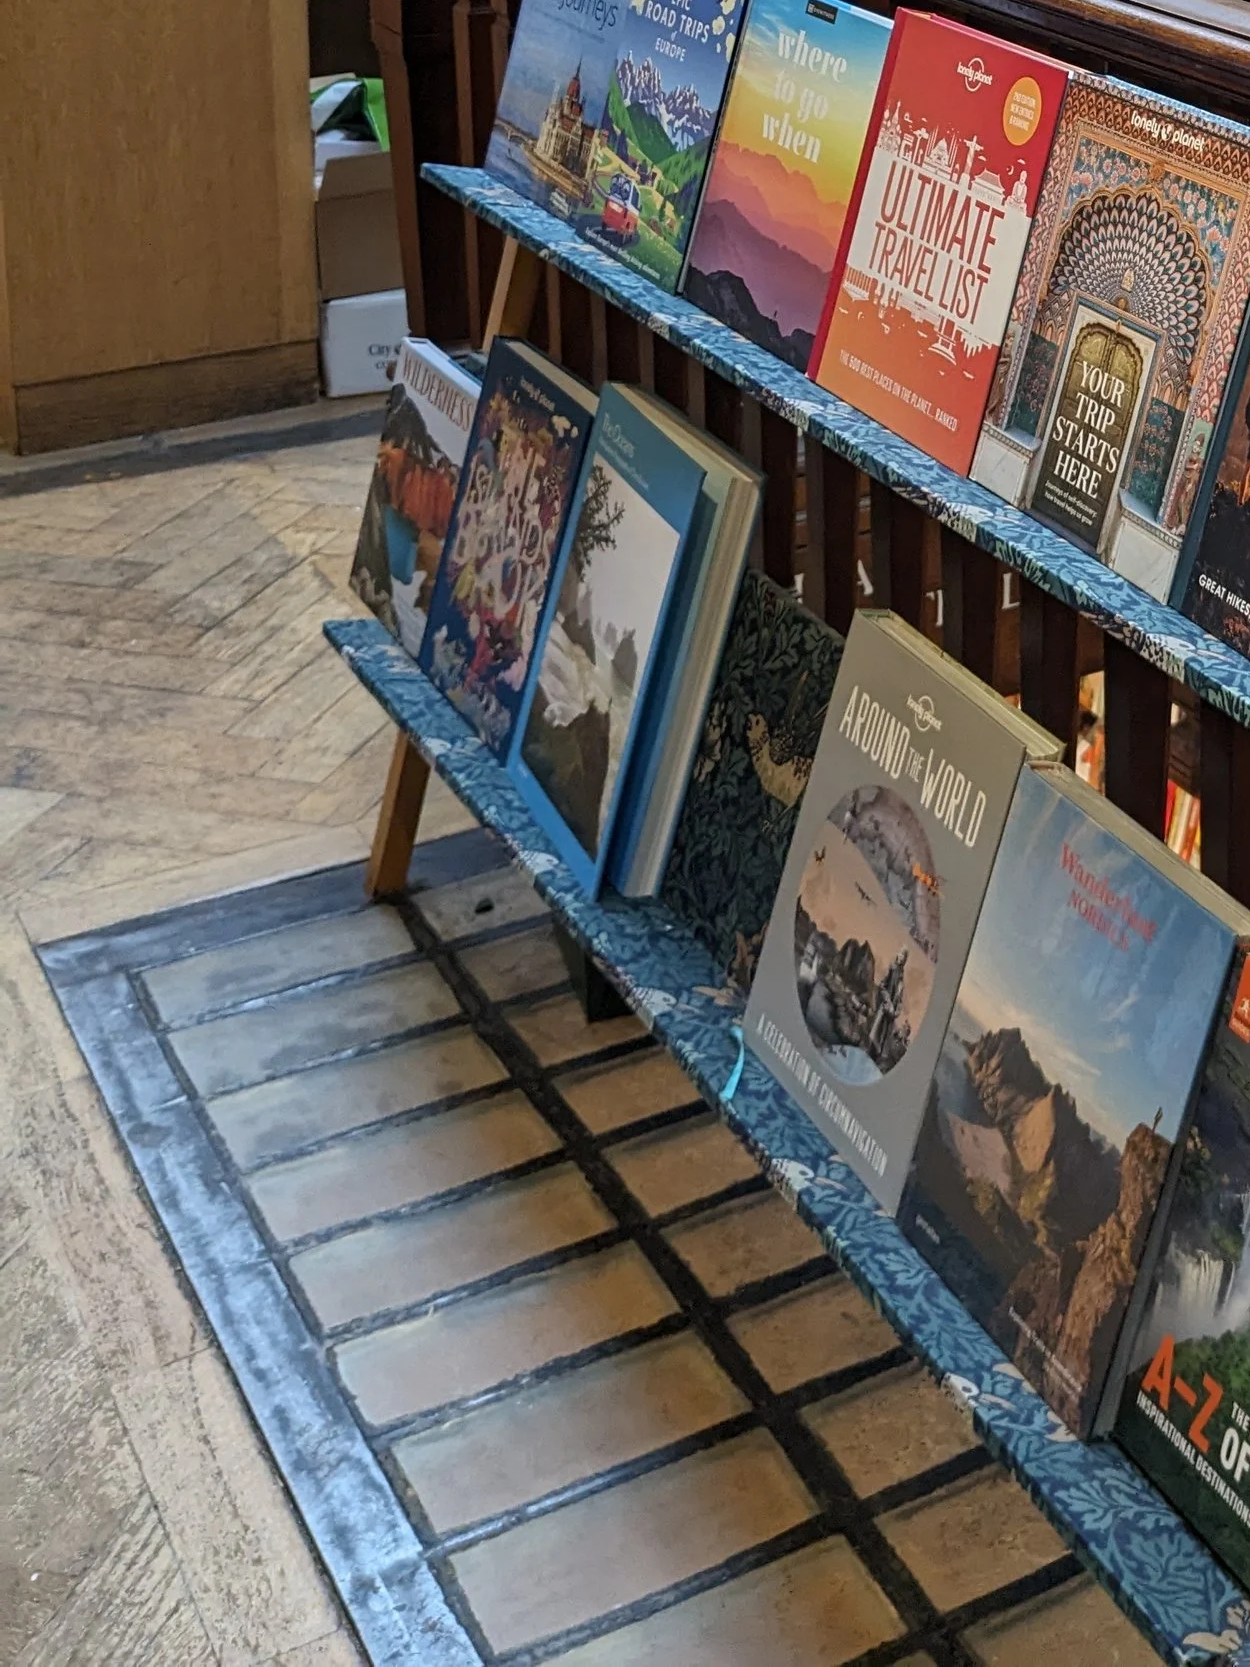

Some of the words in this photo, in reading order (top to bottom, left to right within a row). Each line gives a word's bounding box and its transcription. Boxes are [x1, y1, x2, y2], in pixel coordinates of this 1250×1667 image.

[645, 0, 676, 28] ROAD
[680, 14, 710, 43] TRIPS
[655, 38, 686, 62] EUROPE
[778, 29, 847, 82] where
[957, 61, 974, 82] lonely
[972, 68, 993, 87] planet
[773, 70, 796, 104] to
[797, 87, 829, 123] go
[763, 112, 821, 163] when
[1131, 110, 1161, 137] lonely
[1172, 129, 1206, 151] planet
[880, 160, 1005, 275] ULTIMATE
[868, 222, 934, 303] TRAVEL
[939, 258, 989, 325] LIST
[401, 351, 474, 432] WILDERNESS
[849, 355, 860, 372] 500
[860, 362, 874, 379] BEST
[873, 369, 893, 391] PLACES
[892, 381, 901, 397] ON
[900, 386, 912, 403] THE
[935, 407, 958, 431] RANKED
[1080, 361, 1125, 408] YOUR
[1075, 392, 1116, 434] TRIP
[1053, 415, 1120, 474] STARTS
[1053, 450, 1102, 499] HERE
[1198, 574, 1226, 599] GREAT
[1226, 591, 1250, 619] HIKES,
[905, 694, 927, 718] lonely
[923, 709, 942, 731] planet
[839, 686, 910, 780] AROUND
[906, 746, 925, 783] THE
[920, 747, 987, 848] WORLD
[1060, 842, 1157, 943] Wanderlust
[757, 1013, 765, 1033] A
[763, 1021, 811, 1087] CELEBRATION
[807, 1071, 821, 1097] OF
[818, 1084, 888, 1178] CIRCUMNAVIGATION
[1136, 1390, 1196, 1467] INSPIRATIONAL
[1231, 1401, 1250, 1430] THE
